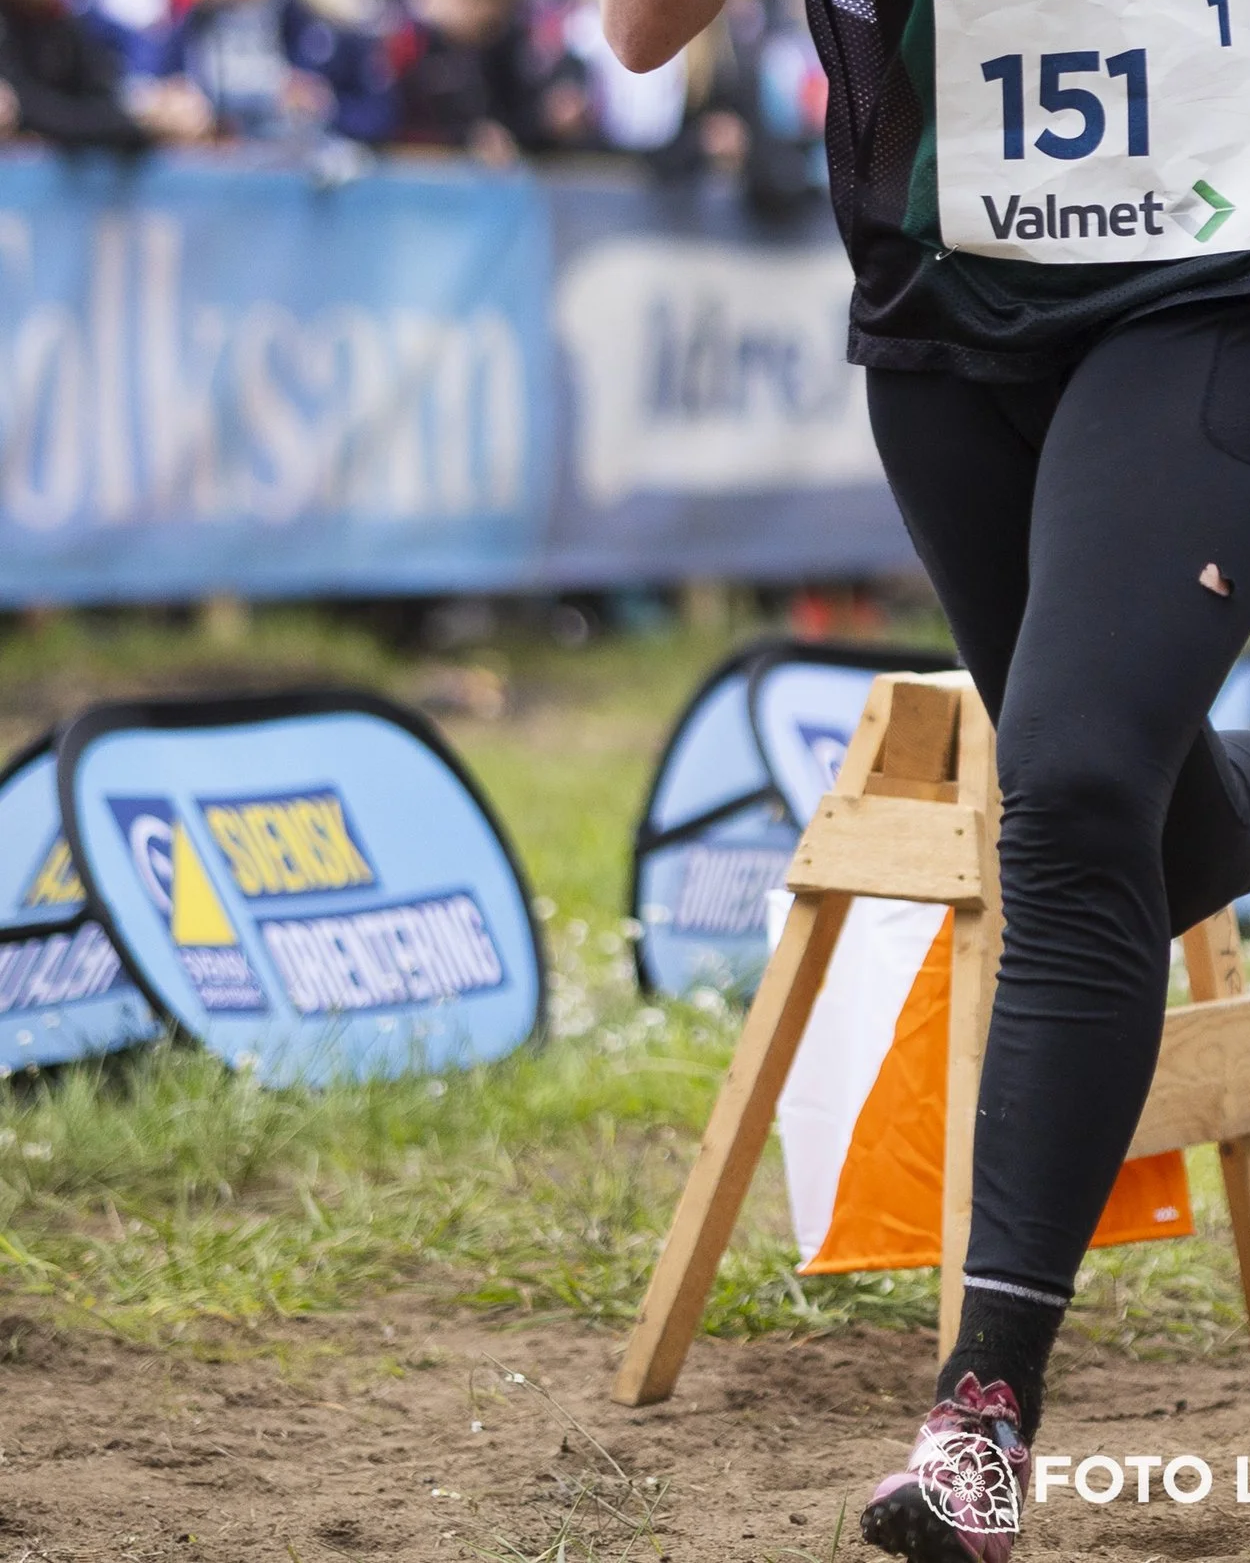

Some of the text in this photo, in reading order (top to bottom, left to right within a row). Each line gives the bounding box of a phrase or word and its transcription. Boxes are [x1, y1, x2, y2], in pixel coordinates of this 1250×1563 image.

[980, 48, 1150, 160] 151
[980, 191, 1165, 240] Valmet
[206, 794, 375, 897] SVENSK
[261, 894, 504, 1013] ORIENTERING
